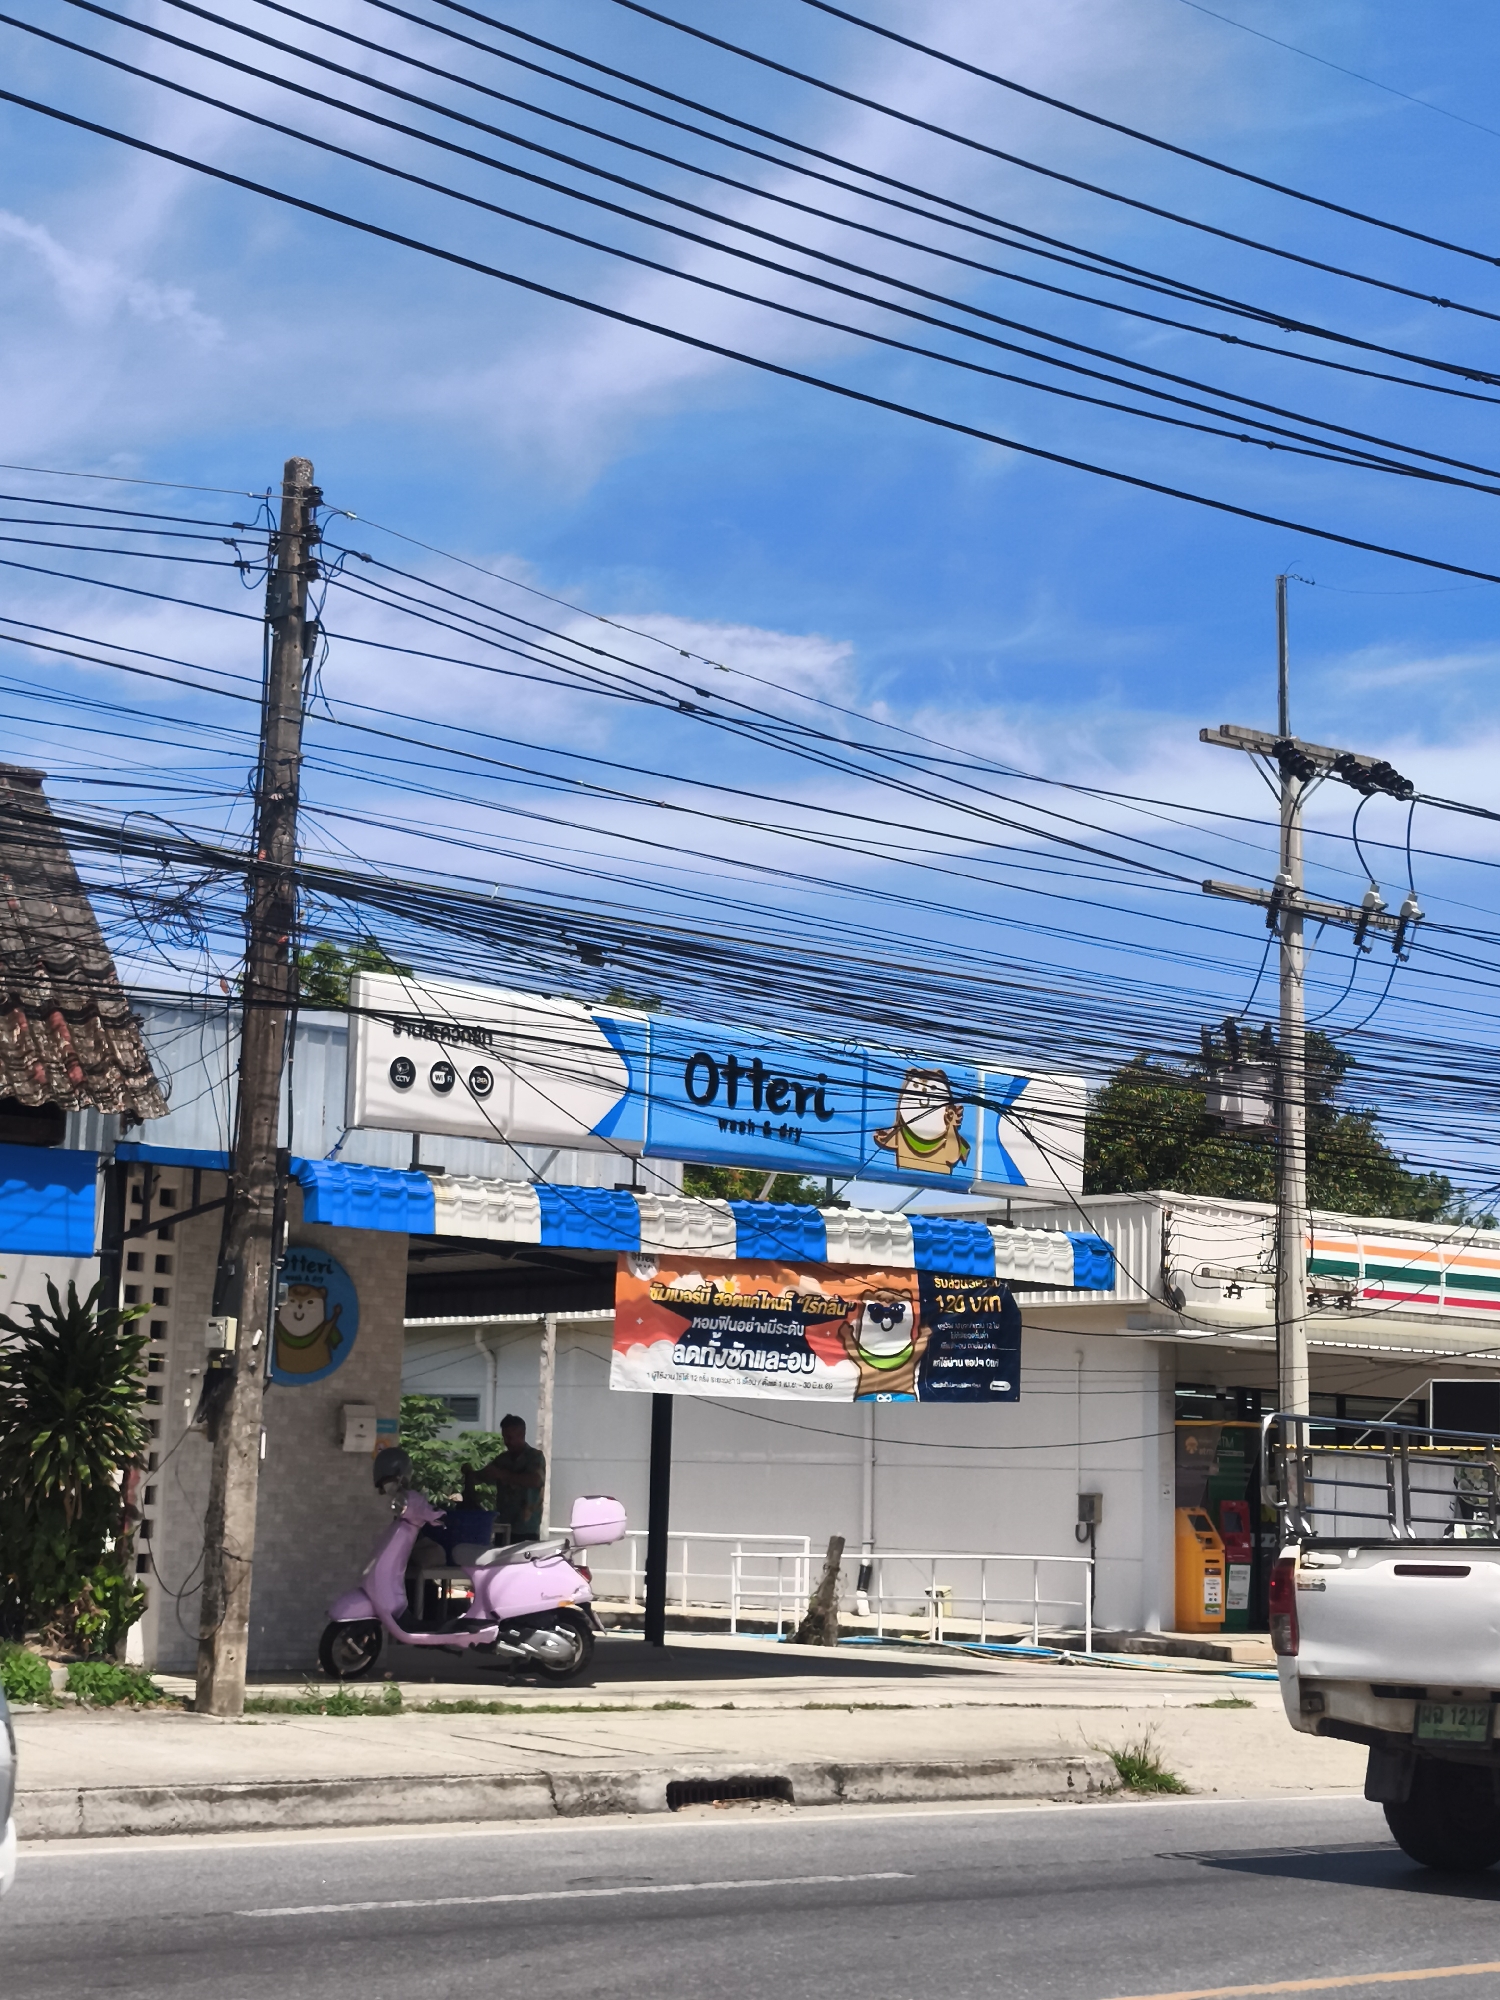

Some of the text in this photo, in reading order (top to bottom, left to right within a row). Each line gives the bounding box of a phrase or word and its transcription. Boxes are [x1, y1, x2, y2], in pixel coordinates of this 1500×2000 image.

[395, 1075, 410, 1083] CCTV
[685, 1052, 834, 1122] Otteri
[649, 1281, 713, 1305] ซัมเมอร์นี้
[969, 1295, 1002, 1313] บาท
[691, 1315, 805, 1337] หอมฟินอย่างมีระดับ
[673, 1332, 815, 1372] ลดทั้งซักและอบ
[1451, 1706, 1488, 1725] 1212
